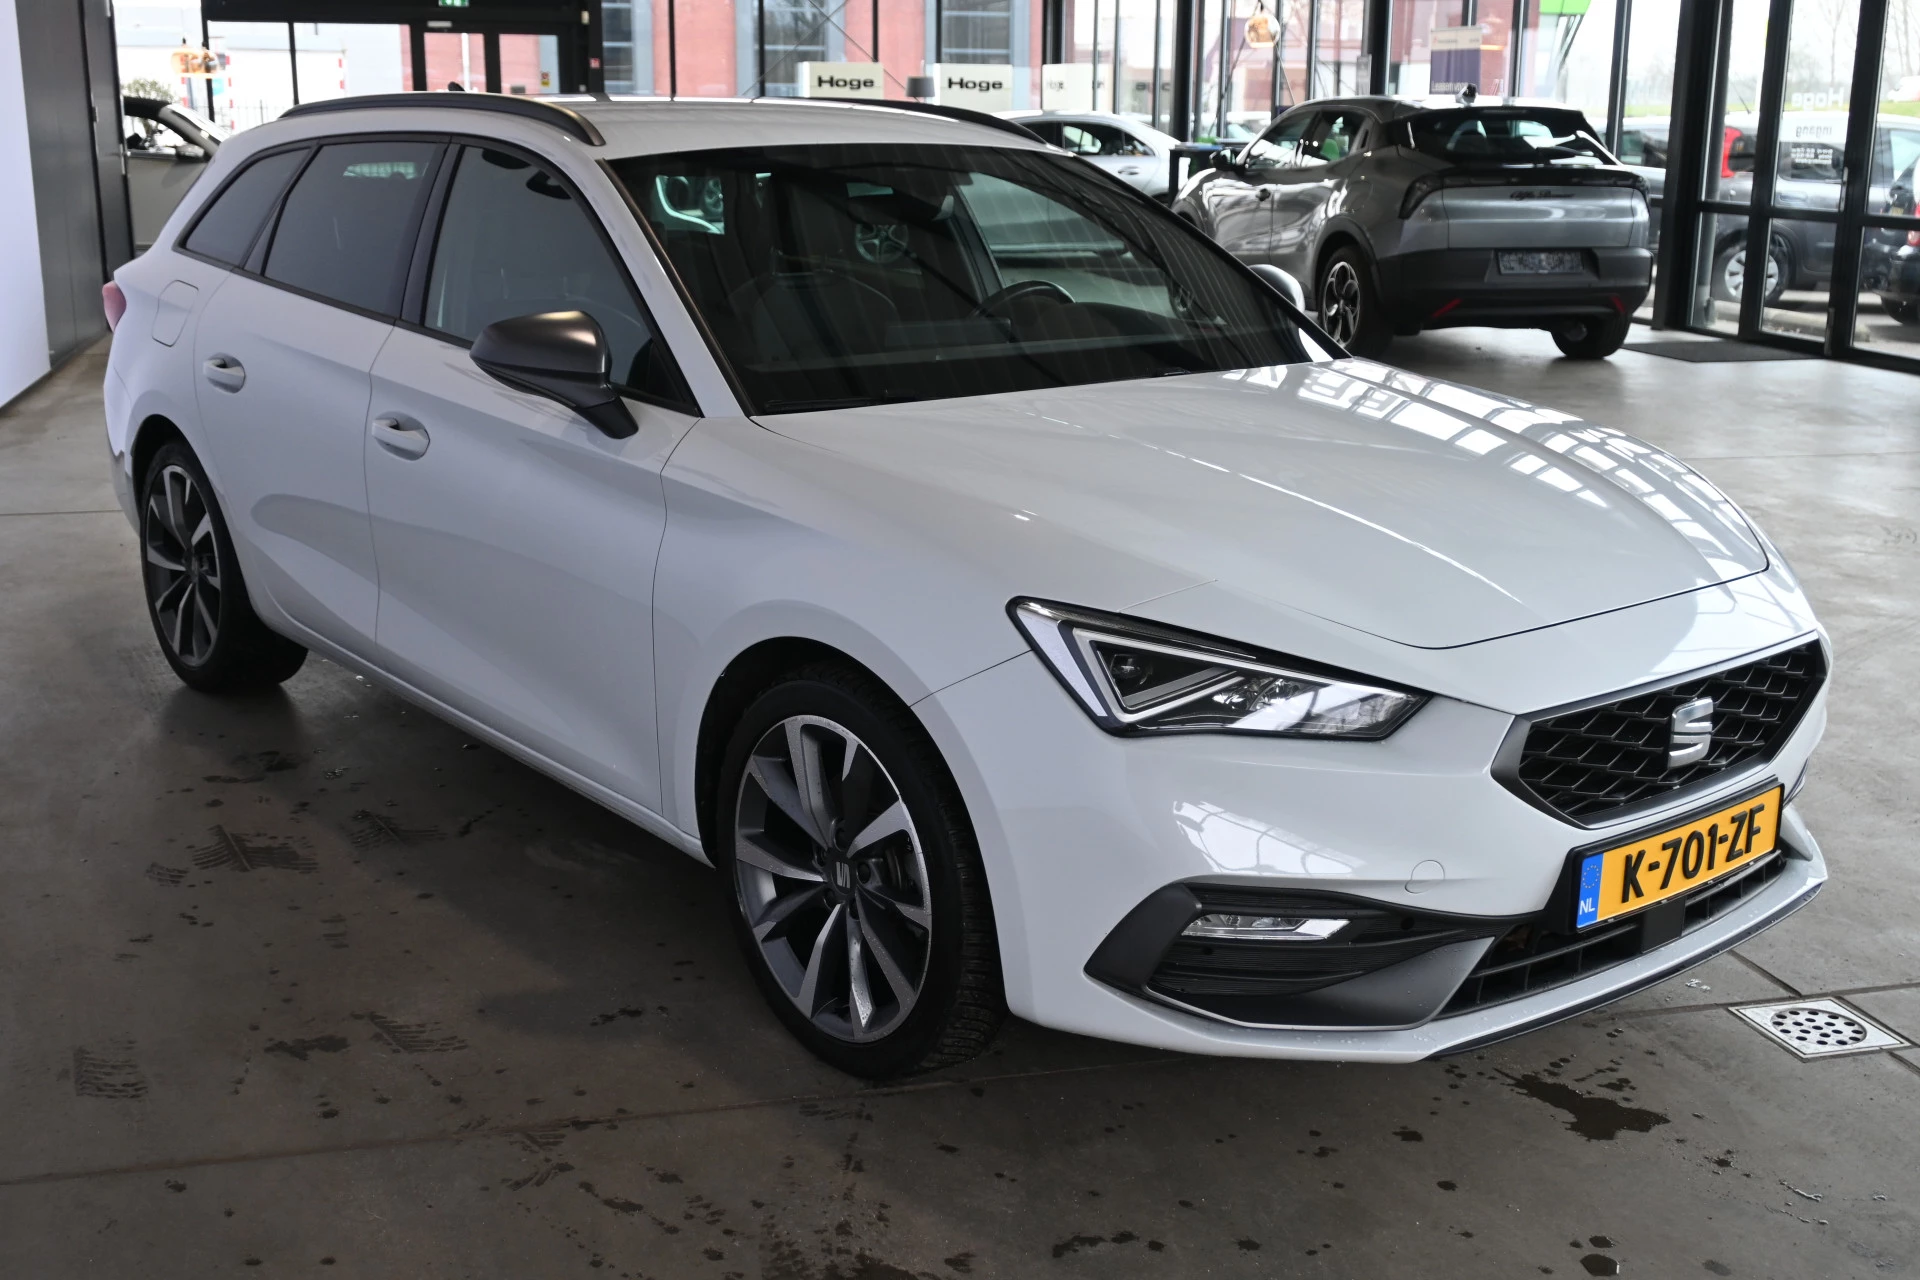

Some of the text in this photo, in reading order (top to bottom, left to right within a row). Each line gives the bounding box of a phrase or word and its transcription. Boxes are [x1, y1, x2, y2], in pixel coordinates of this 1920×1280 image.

[817, 76, 875, 90] Hoge
[948, 77, 1004, 91] Hoge
[1621, 803, 1765, 904] K-701-ZF
[1579, 897, 1596, 916] NL
